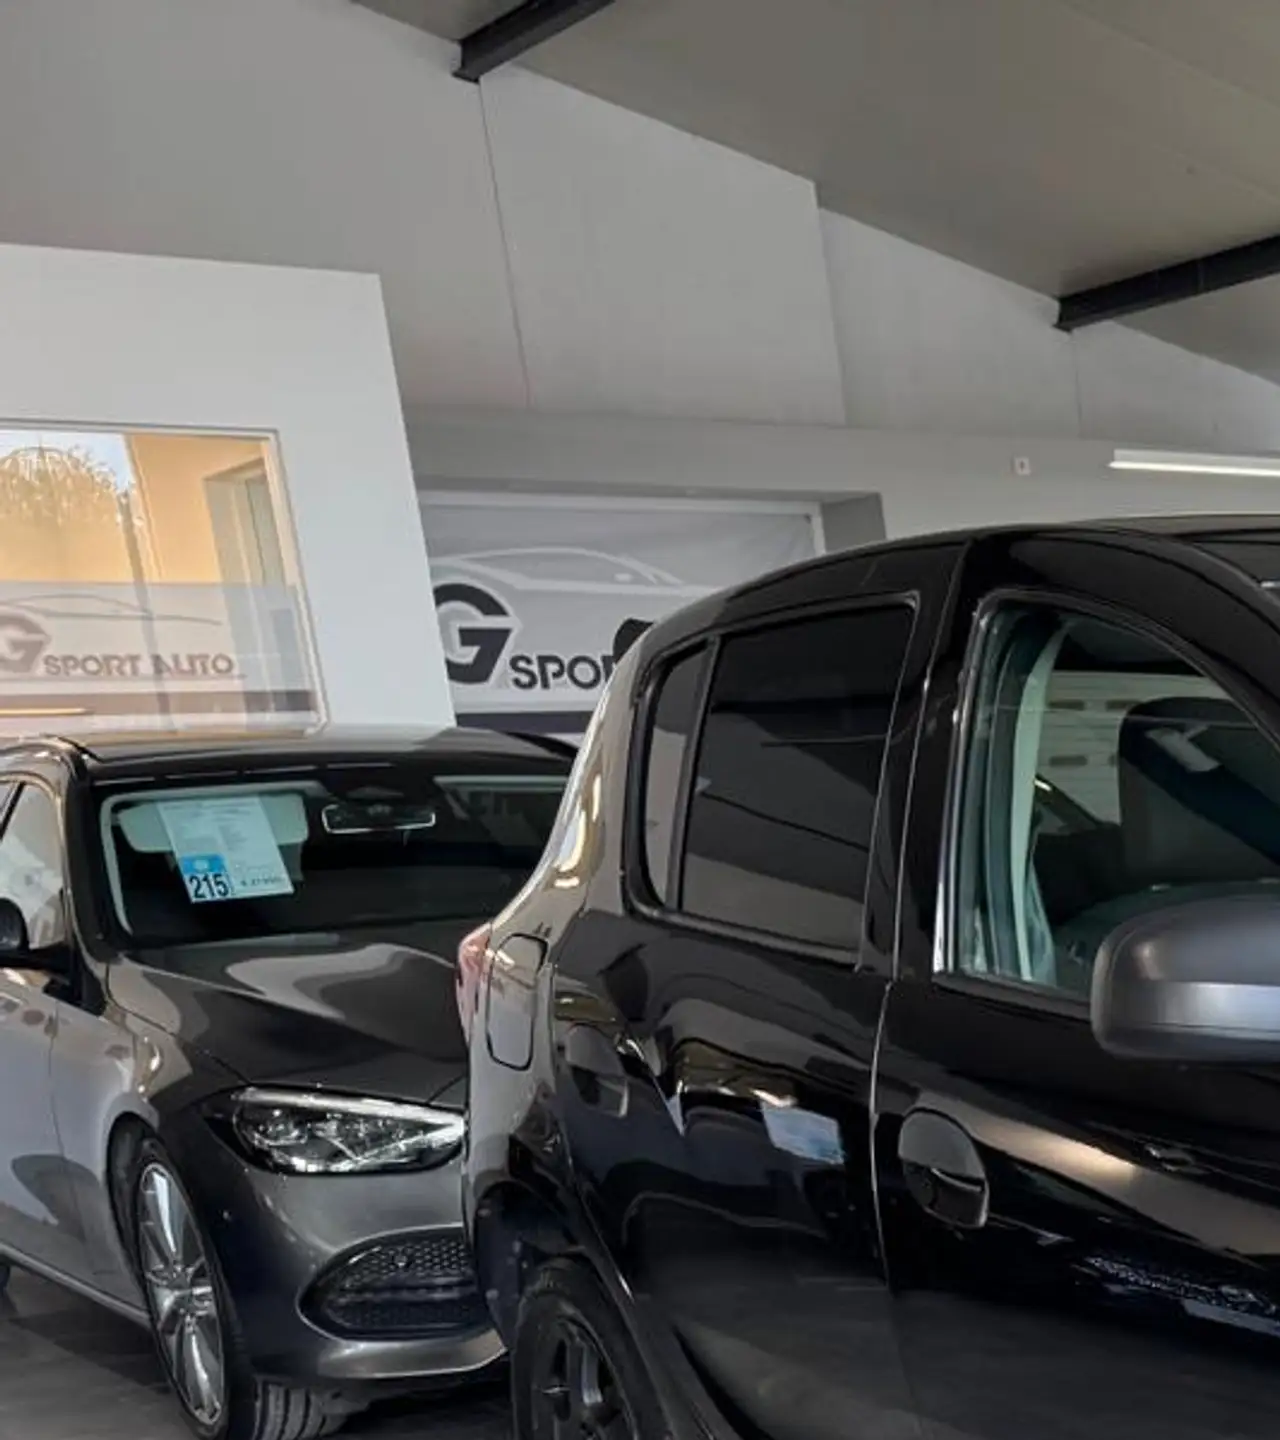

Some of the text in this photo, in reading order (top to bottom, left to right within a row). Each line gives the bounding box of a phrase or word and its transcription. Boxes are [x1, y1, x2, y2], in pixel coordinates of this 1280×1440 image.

[43, 654, 141, 677] SPORT
[152, 653, 234, 676] AUTO
[189, 873, 229, 899] 215
